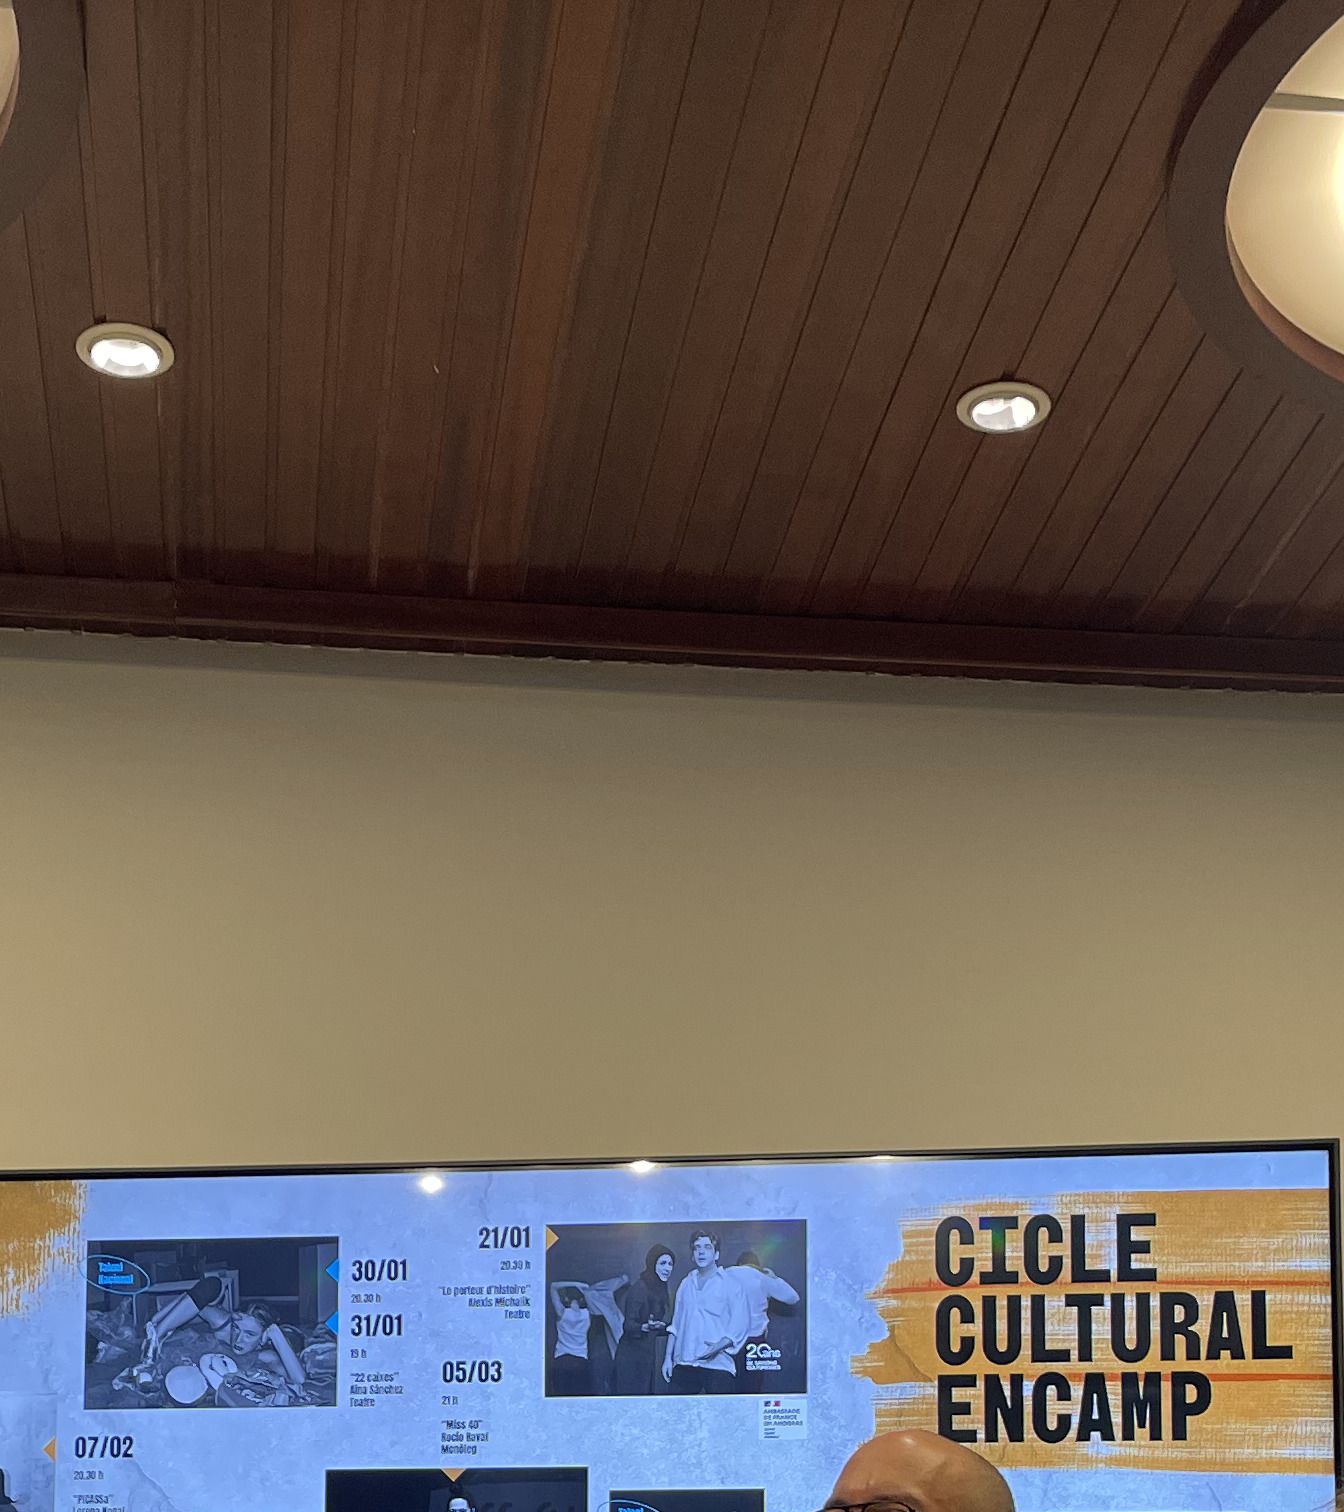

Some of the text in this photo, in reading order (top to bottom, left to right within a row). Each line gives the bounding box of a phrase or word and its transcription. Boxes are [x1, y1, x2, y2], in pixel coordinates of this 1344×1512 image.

[478, 1226, 530, 1249] 21/01
[935, 1213, 1158, 1287] CICLE
[351, 1258, 408, 1282] 30/01
[350, 1314, 403, 1337] 31/01
[935, 1290, 1293, 1366] CULTURAL
[442, 1360, 502, 1383] 05/03
[937, 1371, 1212, 1443] ENCAMP
[74, 1436, 134, 1459] 07/02
